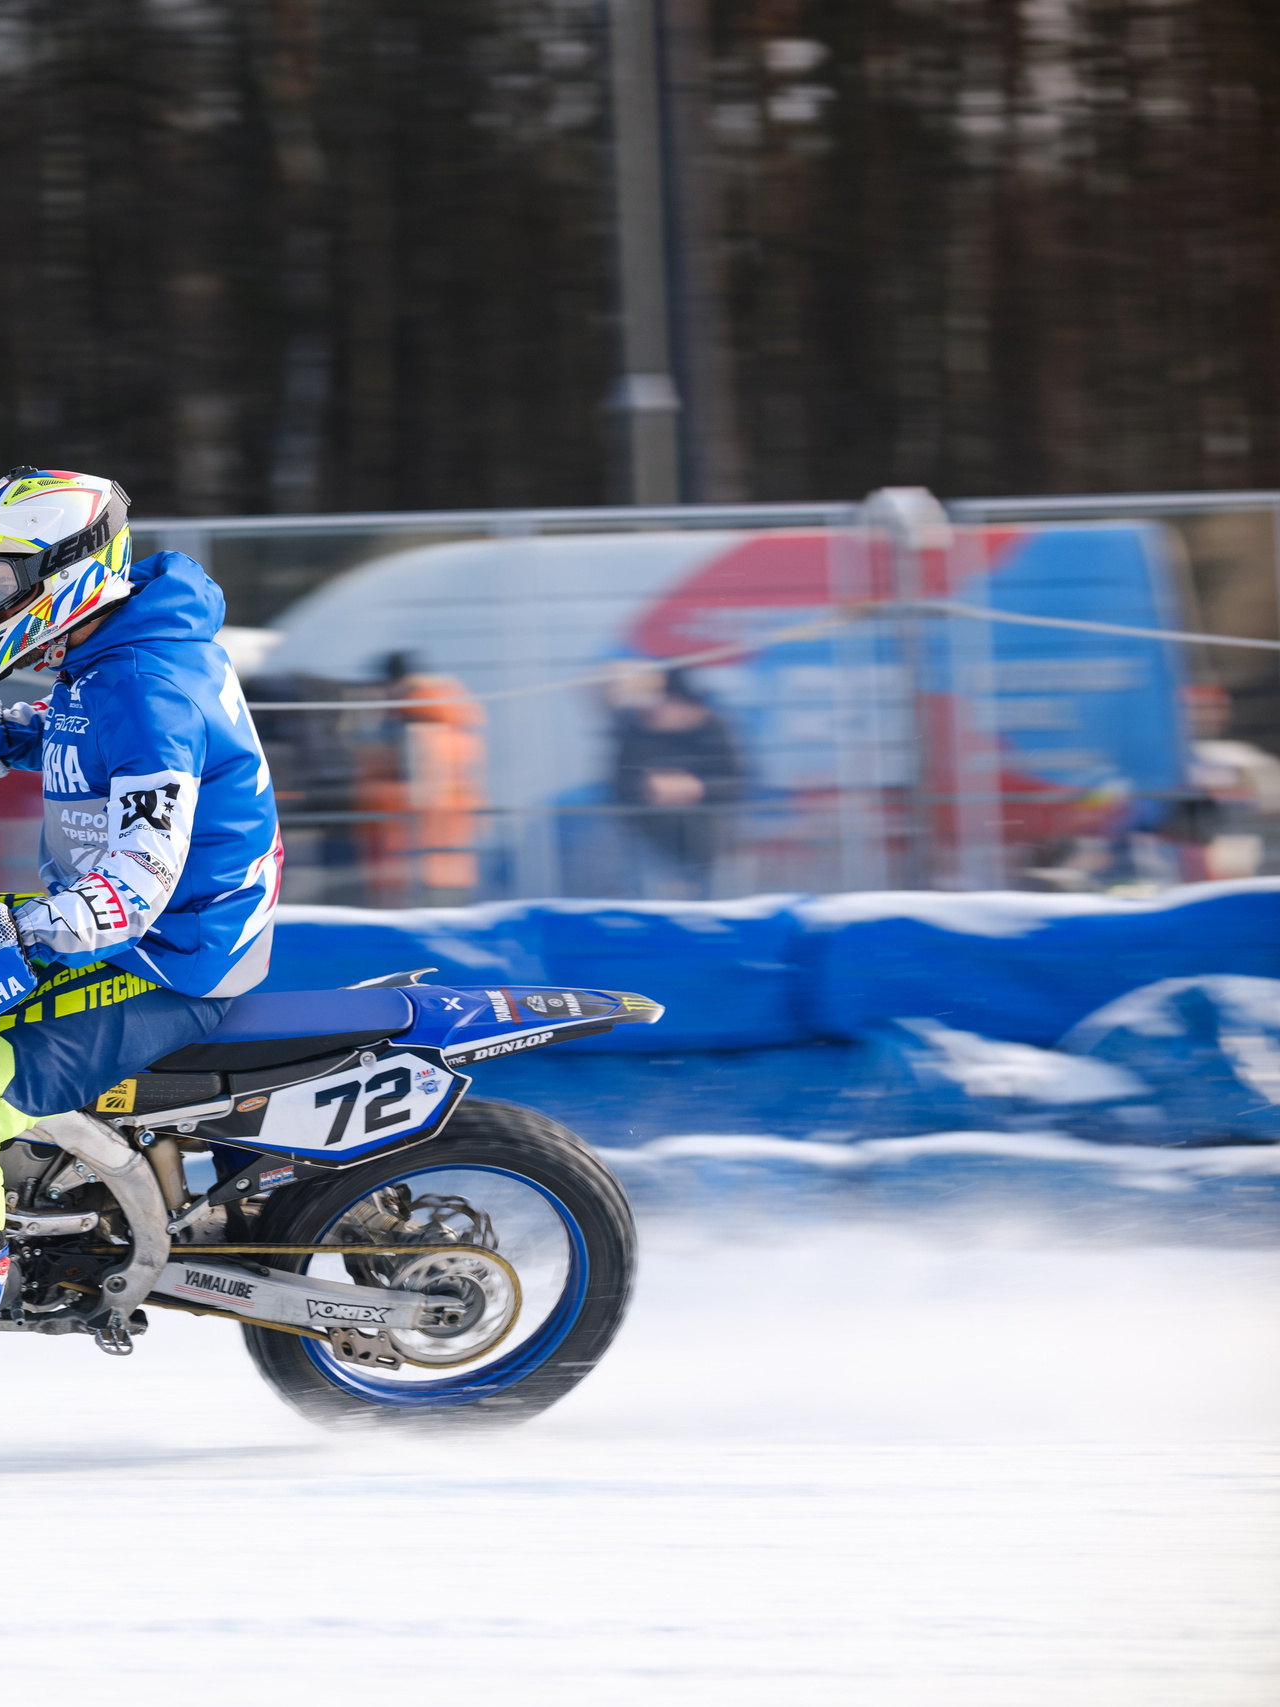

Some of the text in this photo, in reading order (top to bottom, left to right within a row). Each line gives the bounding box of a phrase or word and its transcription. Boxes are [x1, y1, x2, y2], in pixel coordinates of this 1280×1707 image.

[38, 511, 111, 577] LEATT
[60, 808, 107, 829] АГРО
[61, 827, 108, 843] ТРЕЙД
[85, 971, 163, 1011] TECHN
[473, 1031, 554, 1061] DUNLOP
[315, 1066, 411, 1146] 72
[185, 1269, 254, 1300] YAMALUBE
[306, 1299, 391, 1324] VORTEX
